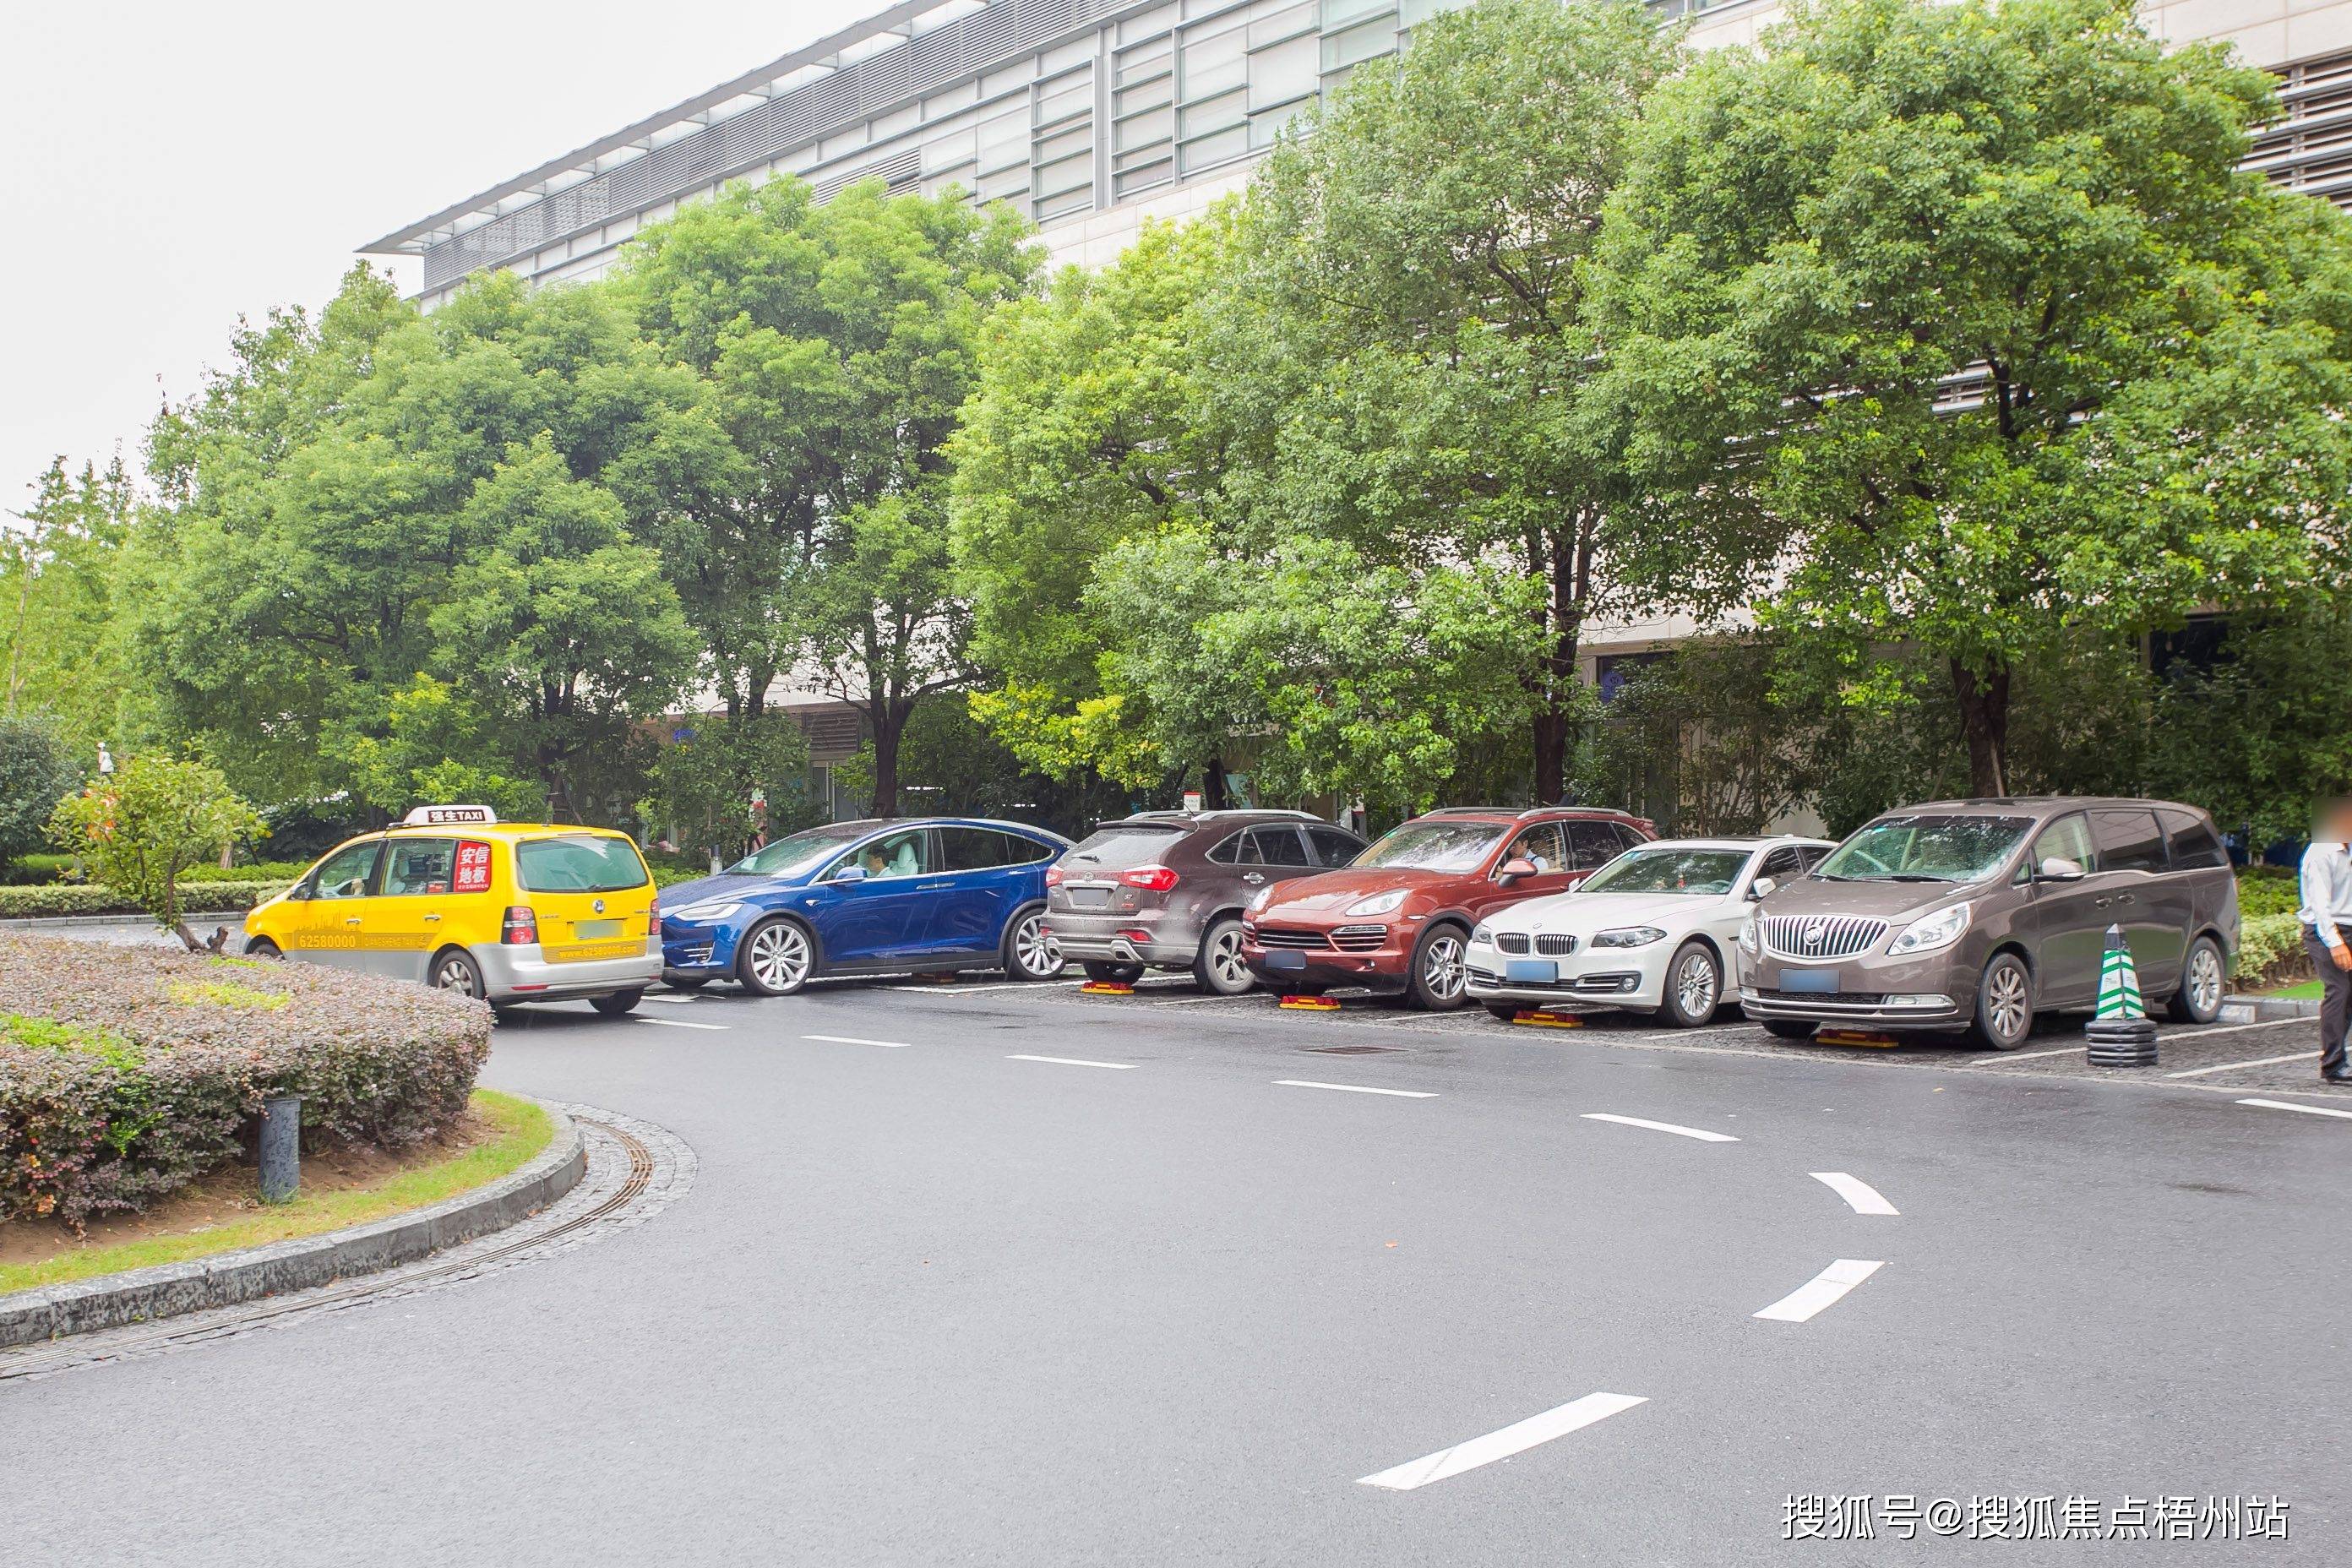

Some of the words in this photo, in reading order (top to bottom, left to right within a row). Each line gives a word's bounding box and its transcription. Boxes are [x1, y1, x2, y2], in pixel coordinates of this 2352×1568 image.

[431, 811, 482, 822] 强生TAXI
[460, 847, 490, 864] 安信
[458, 867, 487, 884] 地板
[299, 935, 356, 948] 62580000
